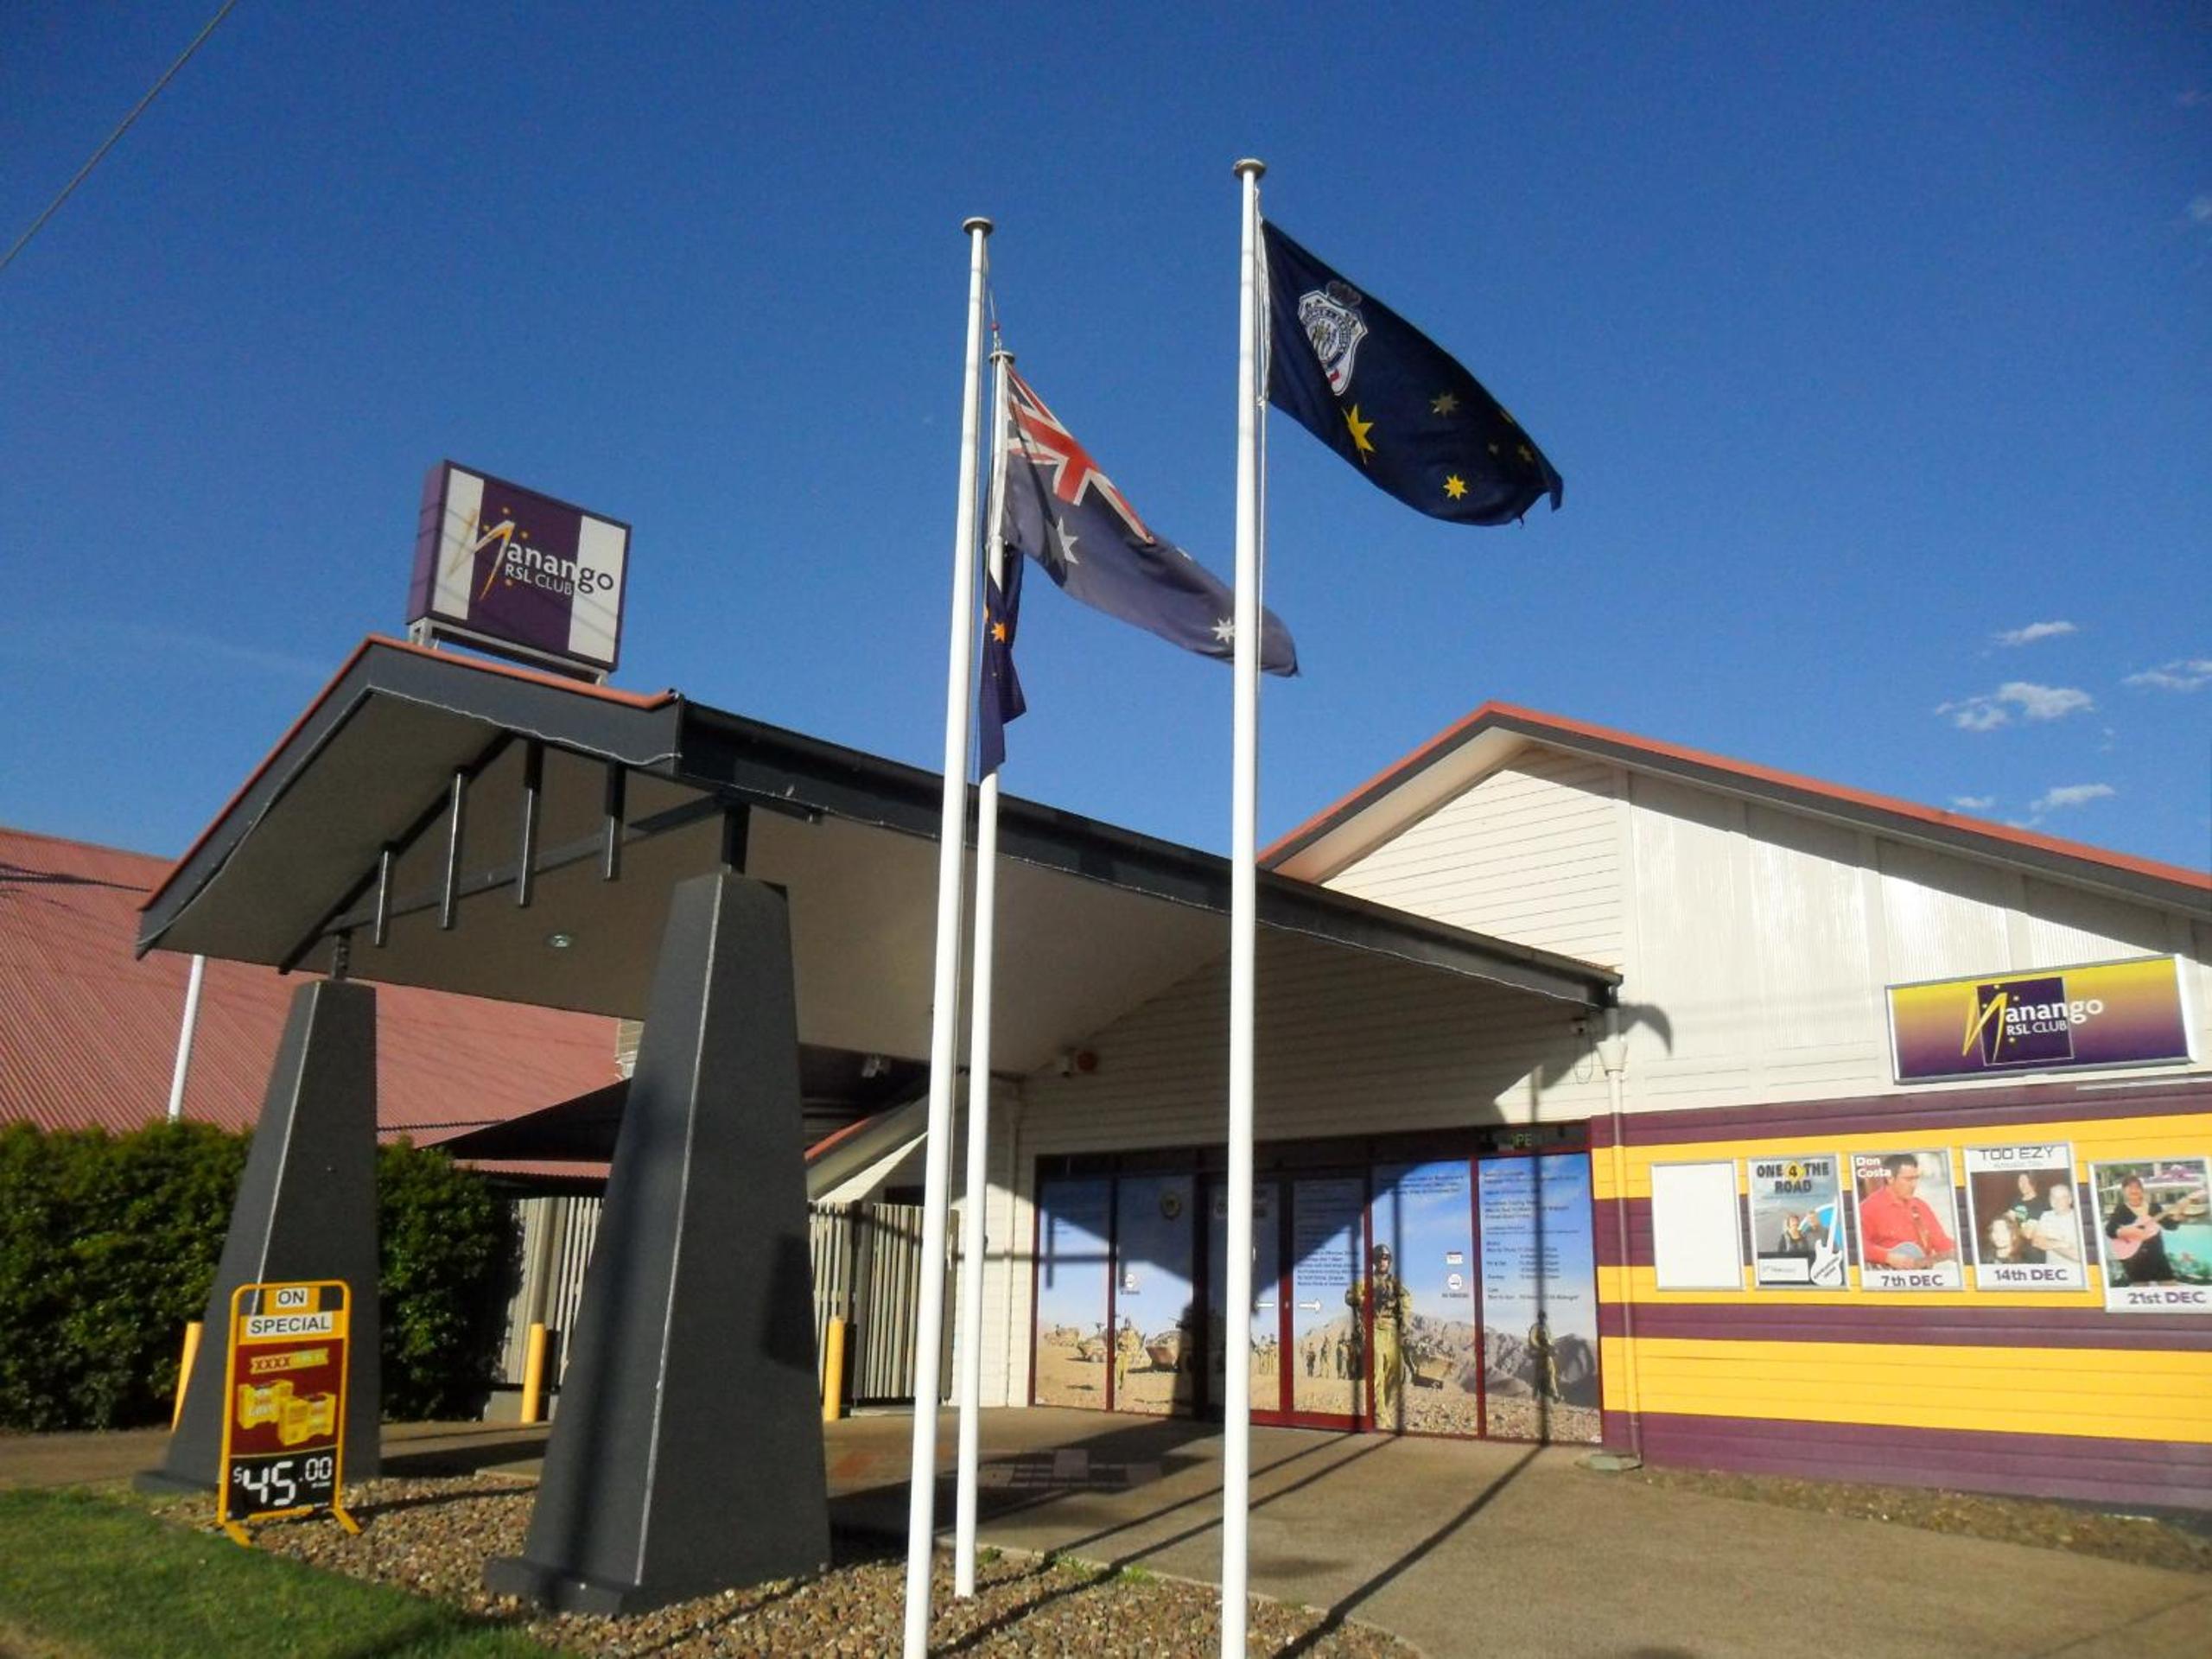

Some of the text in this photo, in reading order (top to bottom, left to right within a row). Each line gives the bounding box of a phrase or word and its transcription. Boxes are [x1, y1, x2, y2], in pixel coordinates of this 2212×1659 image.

[505, 563, 573, 596] RSL CLUB
[2006, 1020, 2068, 1036] RSL CLUB
[1979, 1145, 2054, 1160] TOO EZY
[1856, 1156, 1881, 1166] Don
[1757, 1162, 1829, 1178] ONE 4 THE
[1857, 1167, 1892, 1179] Costa
[1775, 1179, 1813, 1194] ROAD
[1881, 1274, 1943, 1287] 7th DEC
[1994, 1269, 2068, 1281] 14th DEC
[277, 1291, 305, 1305] ON
[2128, 1292, 2206, 1305] 21st DEC
[251, 1316, 330, 1334] SPECIAL
